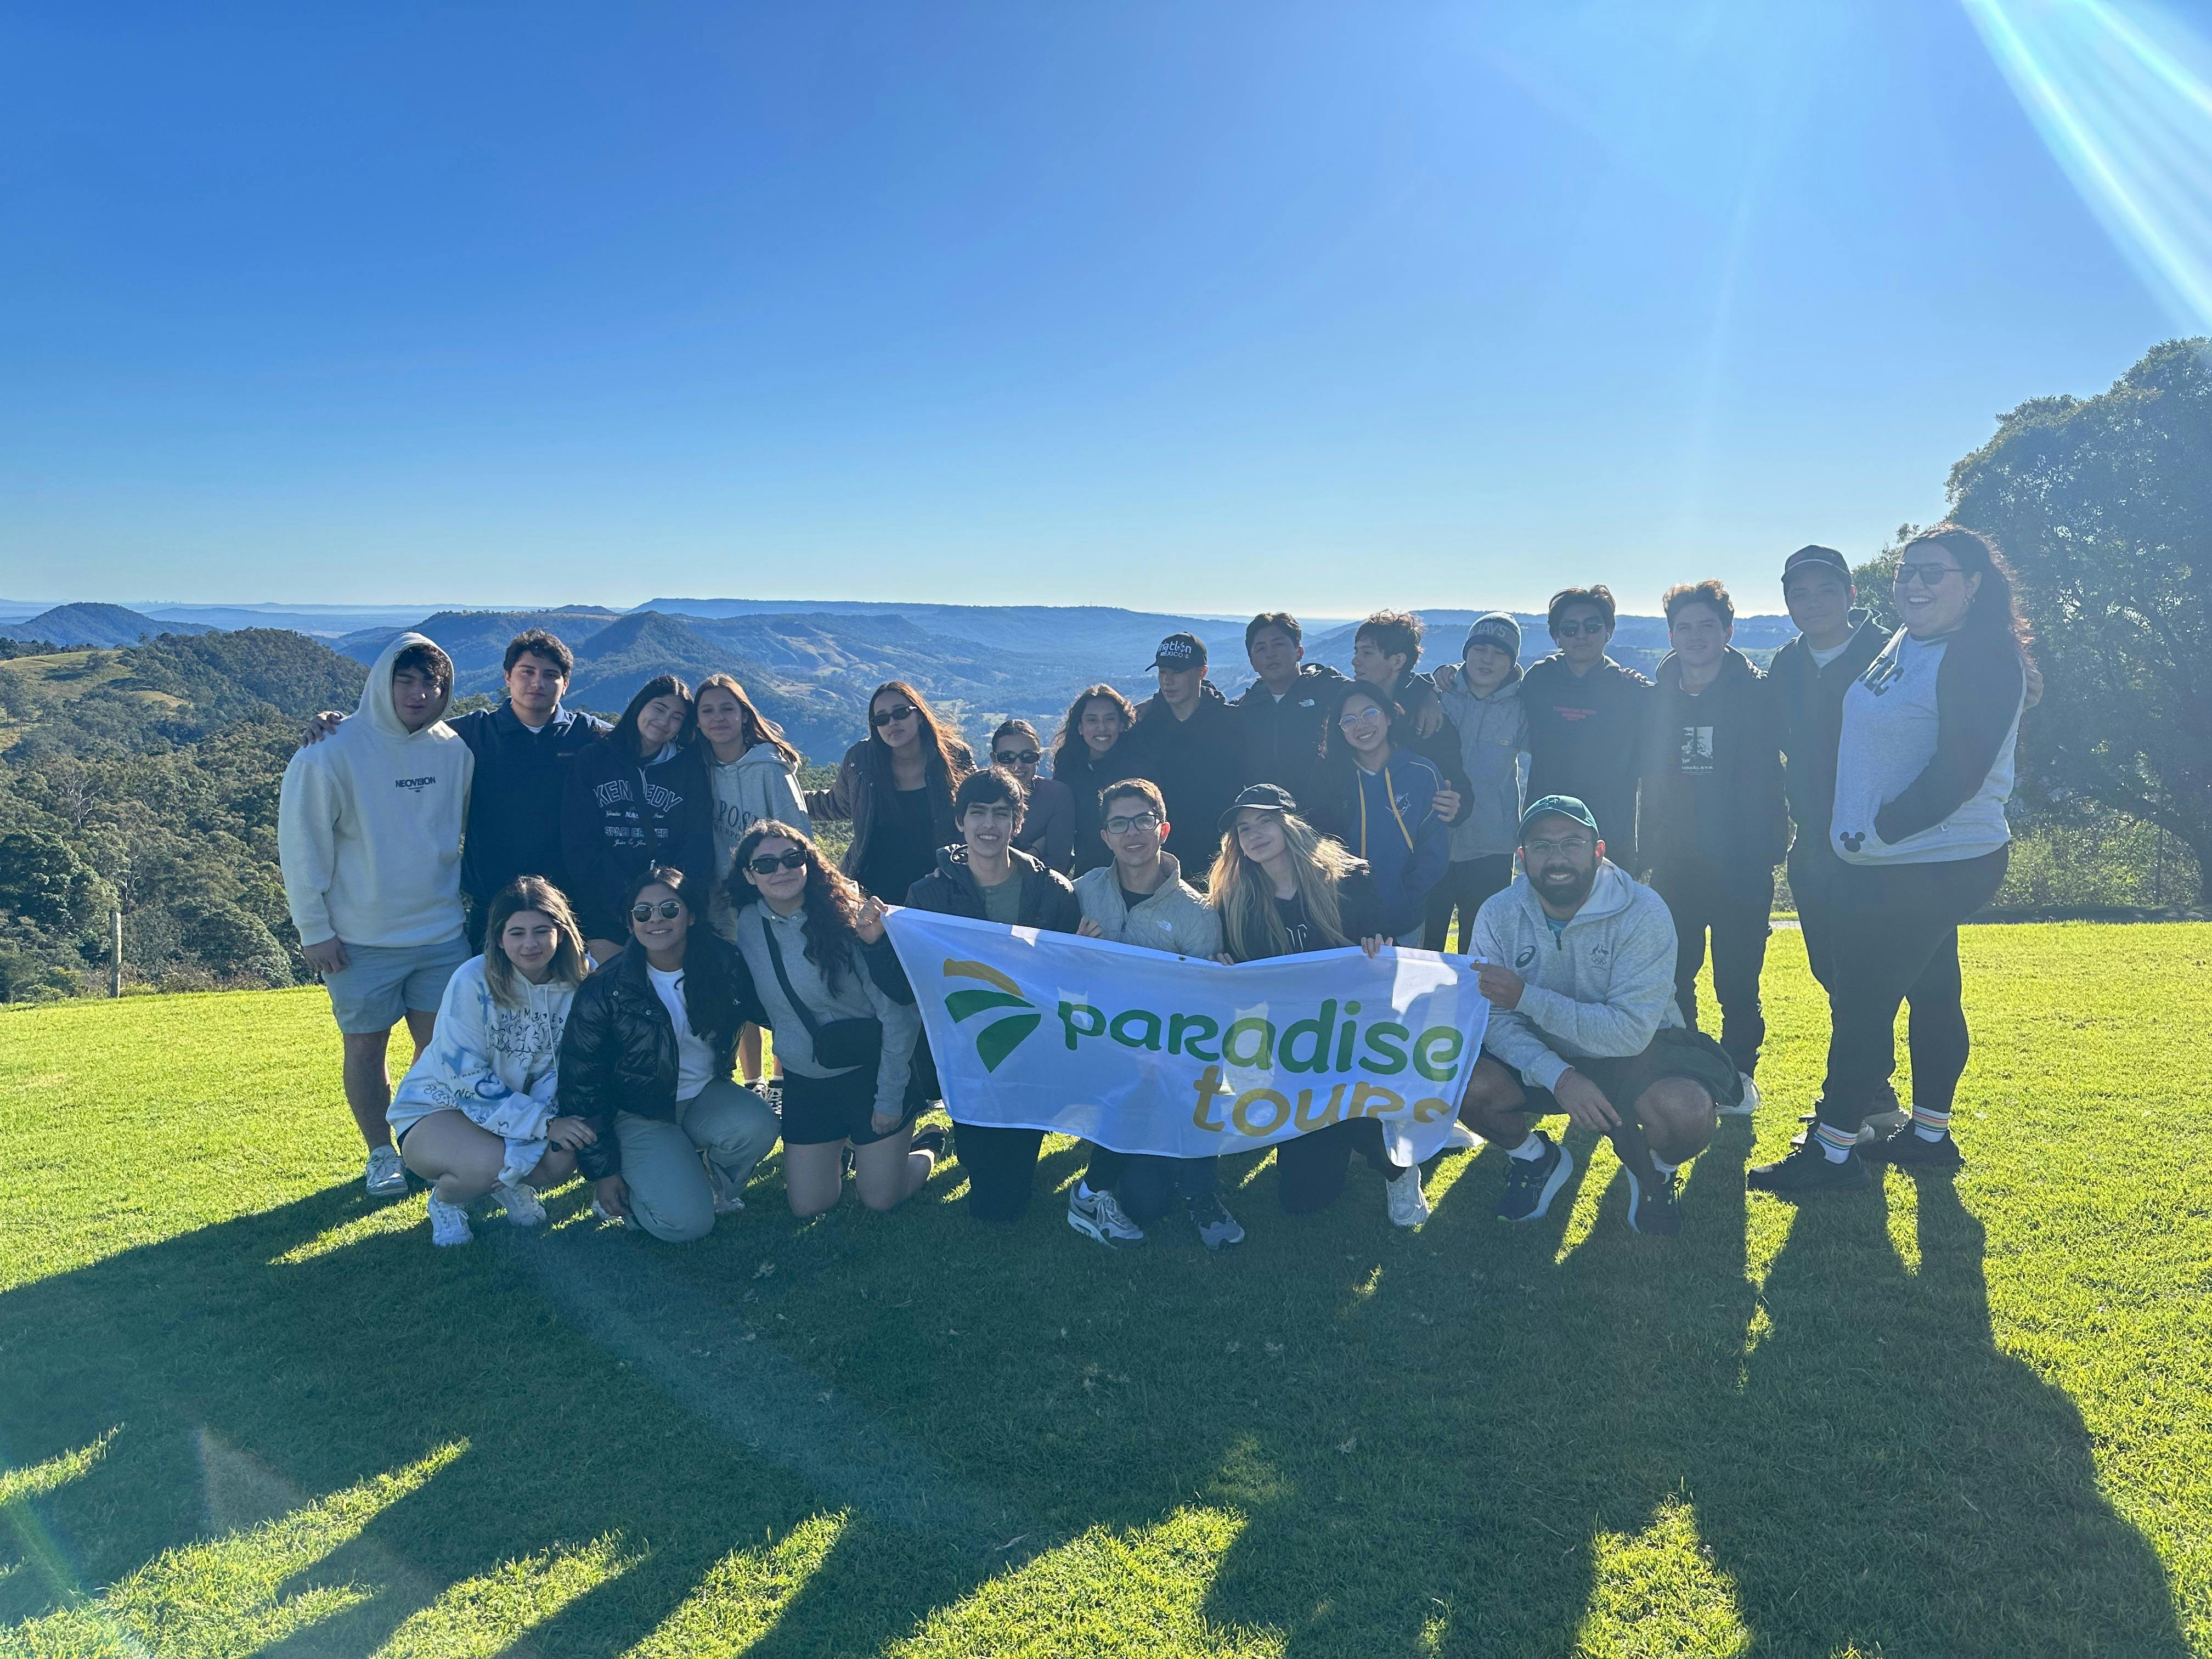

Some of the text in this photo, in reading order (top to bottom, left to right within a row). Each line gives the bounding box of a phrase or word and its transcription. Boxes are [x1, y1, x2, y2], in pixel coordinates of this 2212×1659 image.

[395, 776, 436, 787] NEOVISION
[592, 780, 684, 812] KENEDY
[631, 827, 669, 838] CEER
[1057, 998, 1464, 1082] paradise
